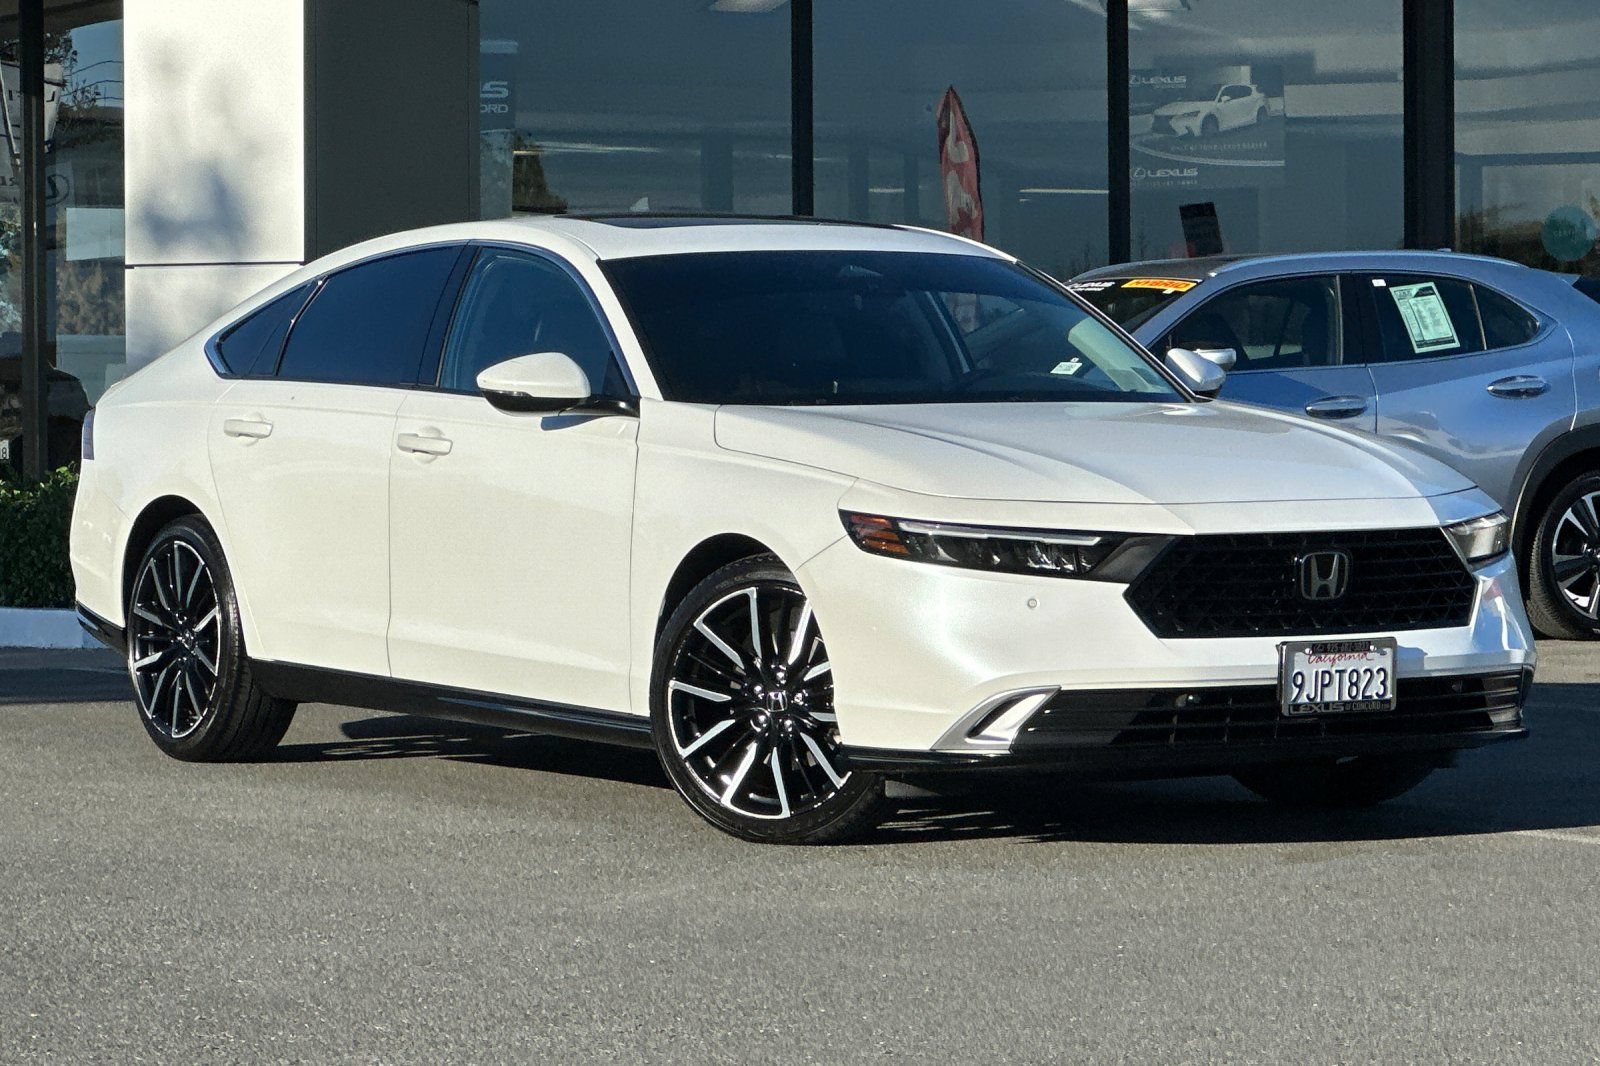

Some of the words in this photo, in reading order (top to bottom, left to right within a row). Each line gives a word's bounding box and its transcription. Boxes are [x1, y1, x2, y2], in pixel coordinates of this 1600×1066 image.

[1142, 75, 1187, 83] LEXUS
[1147, 168, 1199, 177] LEXUS
[1307, 651, 1374, 668] California
[1291, 667, 1388, 703] 9JPT823
[1289, 702, 1345, 714] LEXUS
